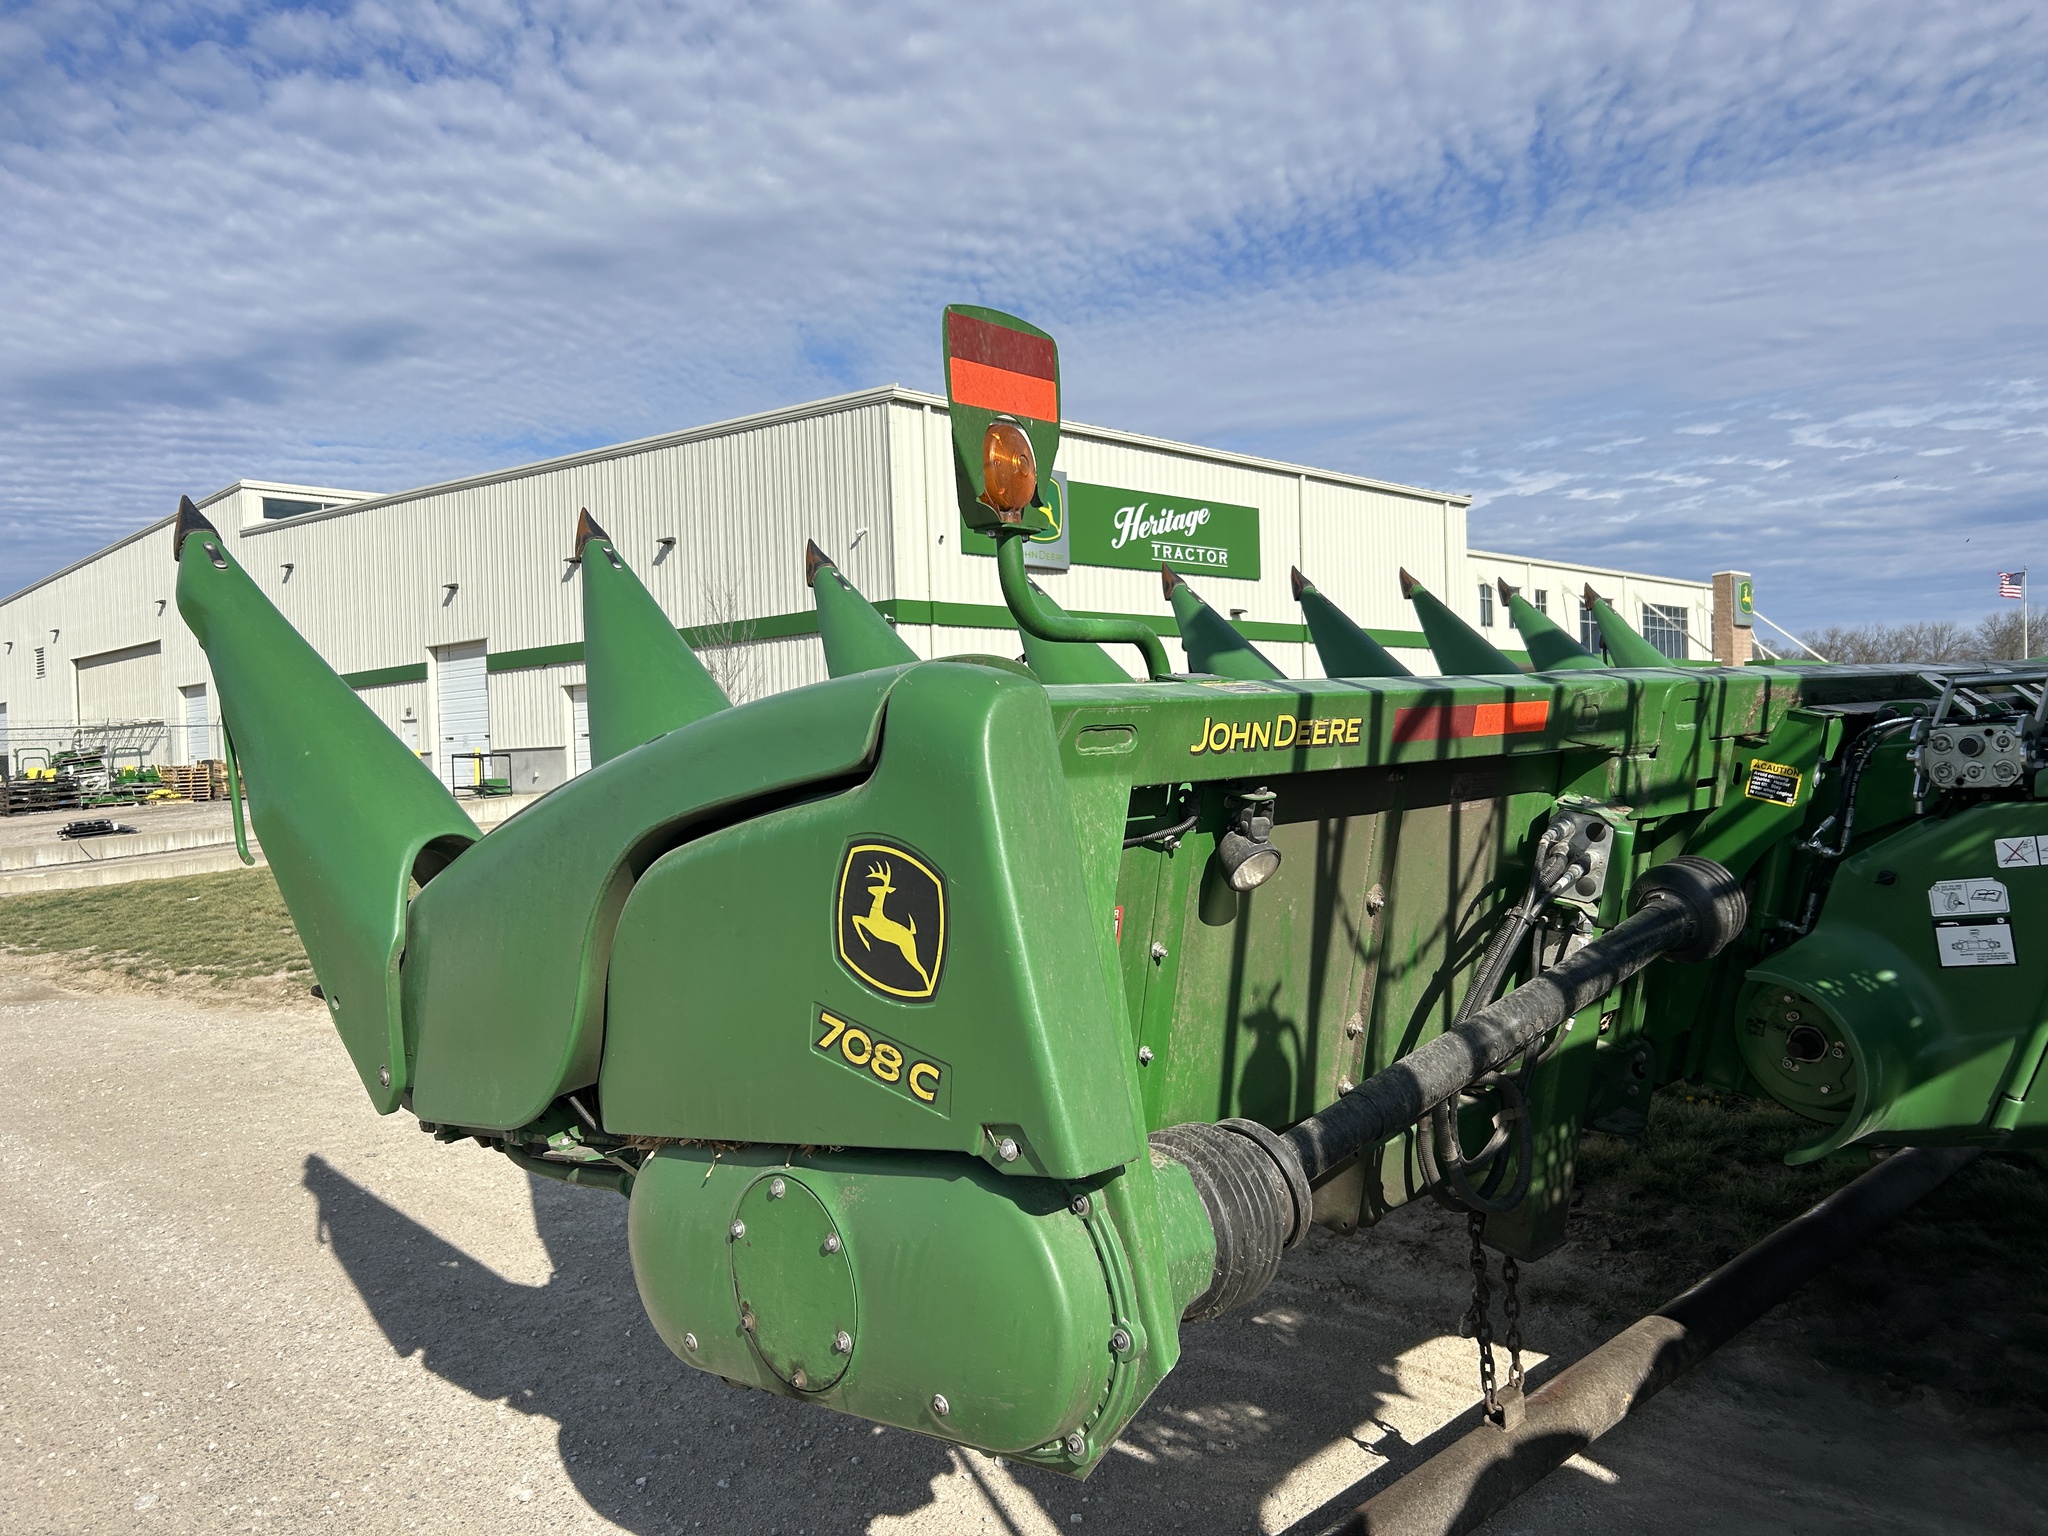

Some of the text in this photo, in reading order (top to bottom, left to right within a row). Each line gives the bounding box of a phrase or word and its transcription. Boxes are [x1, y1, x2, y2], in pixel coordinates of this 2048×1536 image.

[1111, 503, 1210, 549] Heritage
[1151, 544, 1228, 564] TRACTOR
[1190, 713, 1363, 755] JOHN DEERE
[1760, 763, 1800, 777] CAUTION
